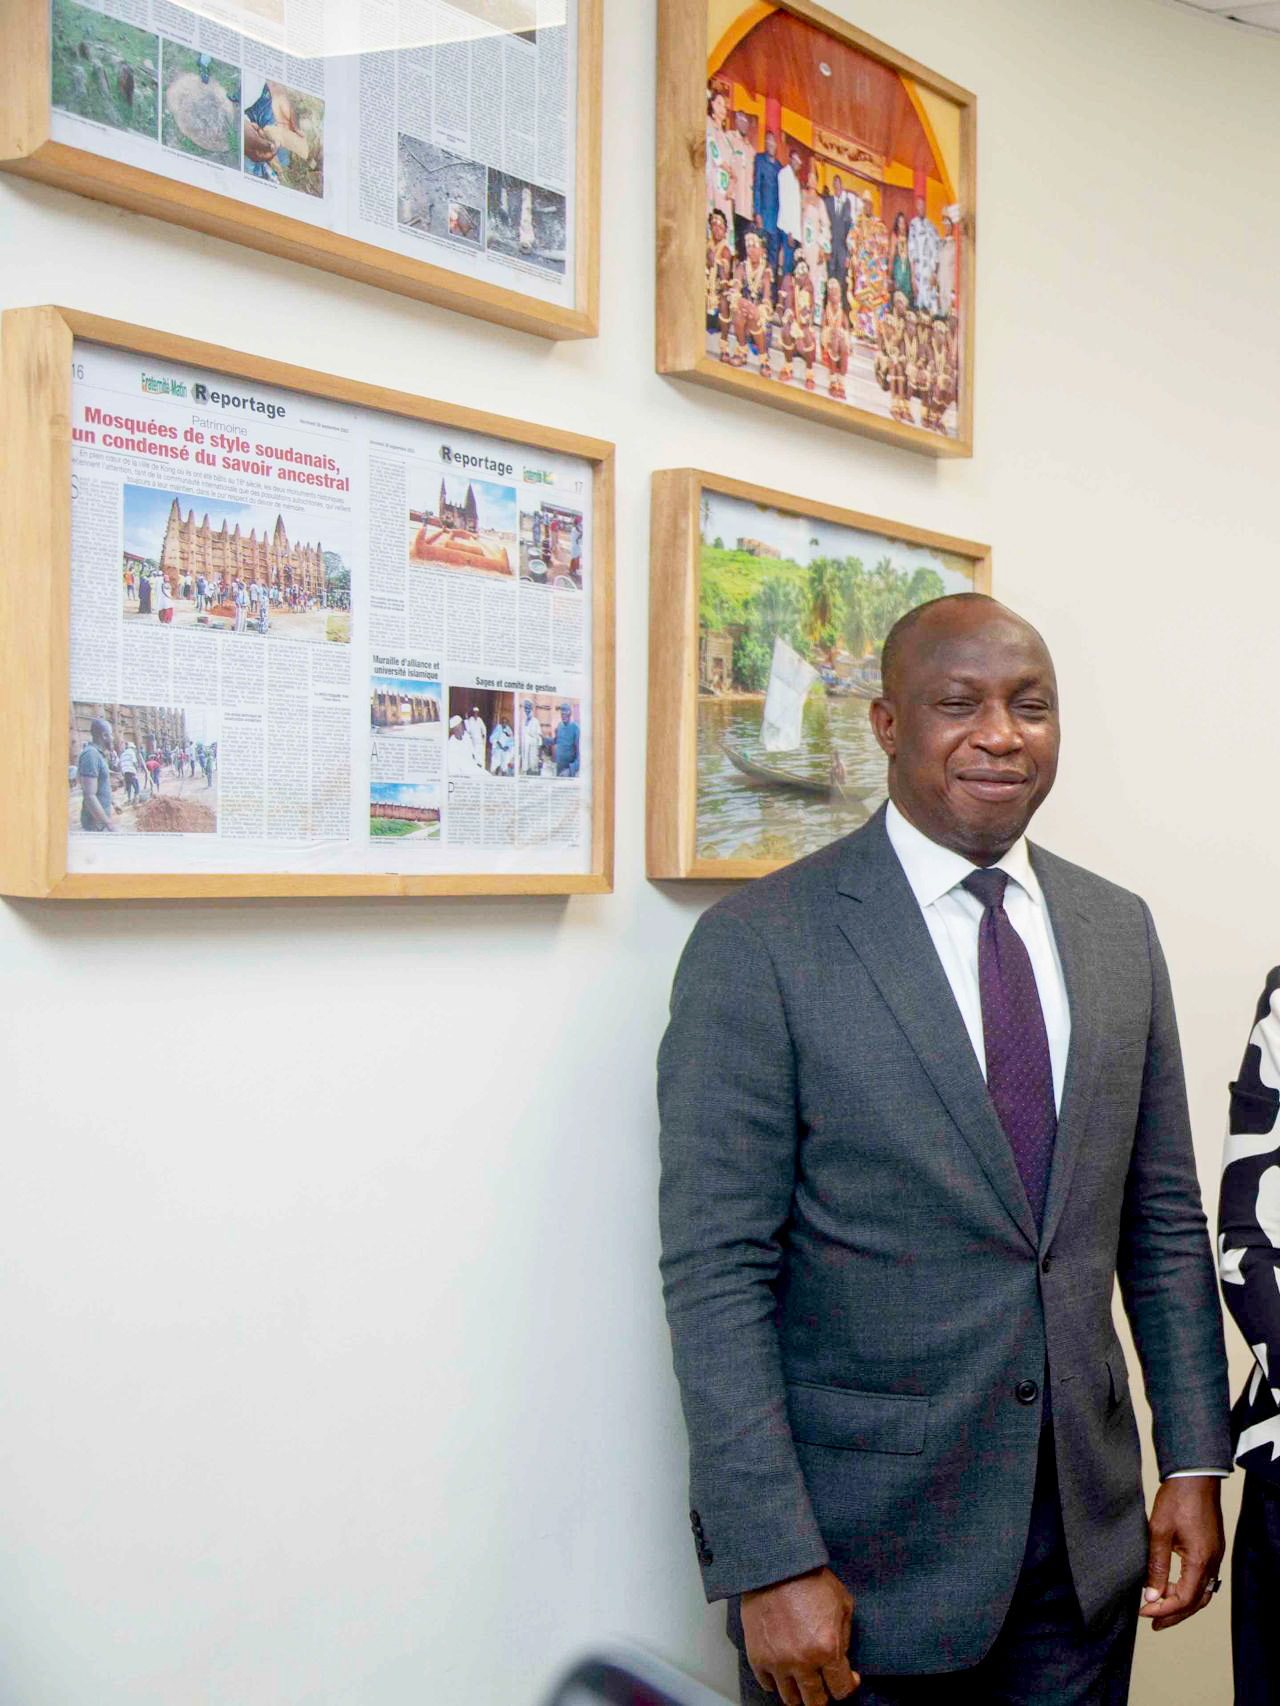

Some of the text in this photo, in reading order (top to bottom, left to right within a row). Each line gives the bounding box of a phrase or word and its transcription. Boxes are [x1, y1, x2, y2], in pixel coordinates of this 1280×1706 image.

[72, 363, 84, 380] 16
[195, 383, 286, 419] Reportage
[192, 415, 248, 436] Patrimoine
[84, 405, 178, 440] Mosquées
[184, 426, 205, 445] de
[210, 433, 250, 458] style
[255, 442, 341, 475] soudanais,
[72, 427, 350, 492] un condensé du savoir ancestral
[160, 463, 177, 474] Kong
[442, 446, 513, 477] Reportage
[373, 655, 440, 670] Muraille d'alliance et
[374, 665, 438, 680] université islamique
[475, 676, 557, 693] Sages et comité de gestion
